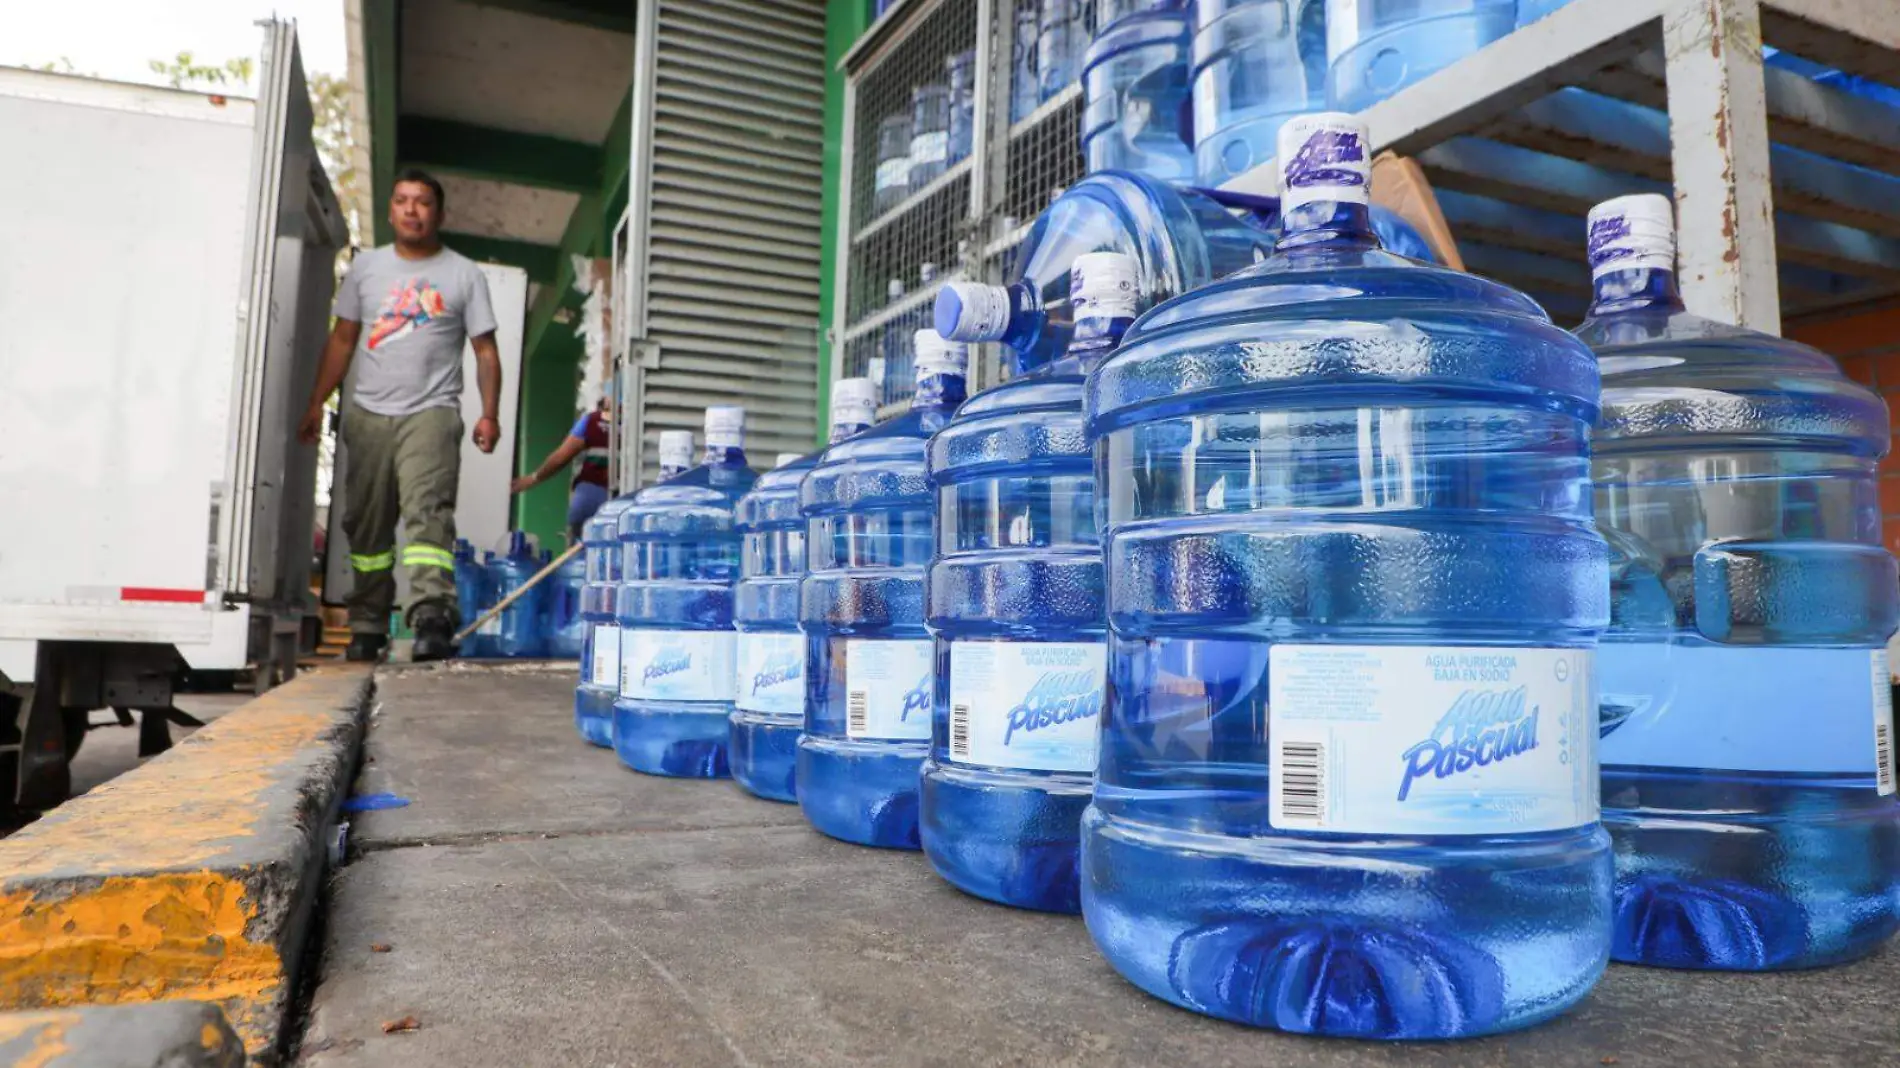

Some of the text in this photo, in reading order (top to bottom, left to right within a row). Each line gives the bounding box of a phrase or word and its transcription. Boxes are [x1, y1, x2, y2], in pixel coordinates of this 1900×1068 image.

[641, 653, 692, 687] Pascual
[1425, 654, 1517, 668] AGUA PURIFICADA
[1434, 669, 1510, 682] BAJA EN SODIO
[1430, 684, 1526, 741] Agua
[1397, 704, 1539, 802] Pascual
